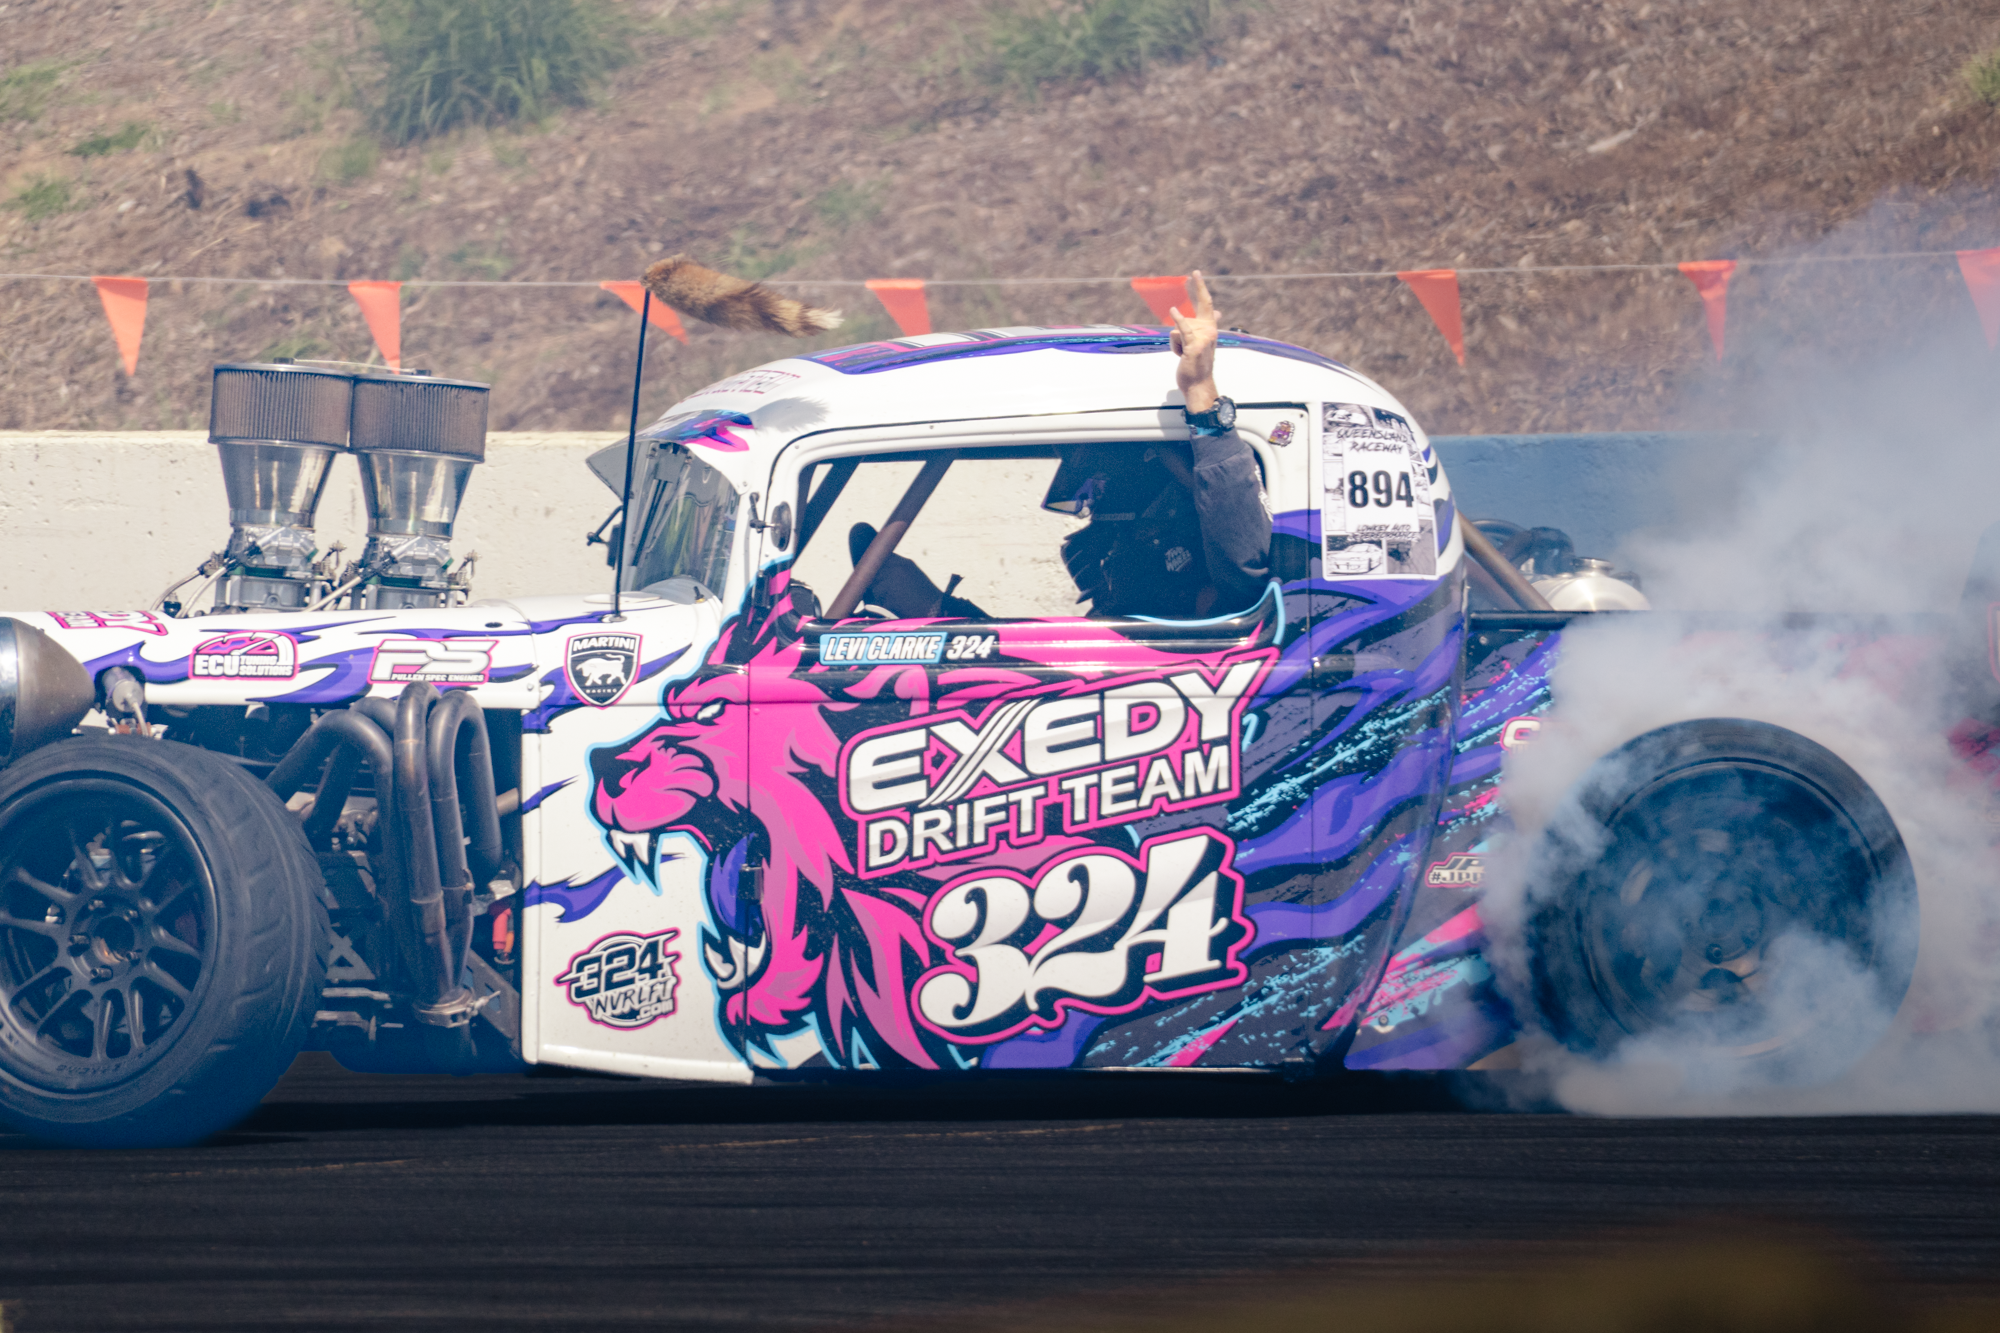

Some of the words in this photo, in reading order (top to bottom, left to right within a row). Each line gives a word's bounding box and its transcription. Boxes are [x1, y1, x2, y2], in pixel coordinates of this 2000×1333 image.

[1337, 428, 1408, 442] QUEENSLAND
[1350, 442, 1404, 453] RACEWAY
[1348, 469, 1414, 509] 894
[573, 637, 635, 651] MARTINI
[823, 636, 870, 662] LEVI
[867, 635, 942, 661] CLARKE
[945, 635, 995, 660] 324
[195, 654, 240, 676] ECU
[239, 655, 278, 666] TUNING
[239, 665, 294, 676] SOLUTIONS
[391, 673, 425, 681] PULLEN
[424, 674, 447, 682] SPEC
[447, 674, 486, 682] ENGINES
[849, 660, 1262, 812] EXEDY
[867, 785, 1046, 868] DRIFT
[1062, 744, 1231, 821] TEAM
[919, 834, 1230, 1028] 324
[564, 936, 668, 1002] 324
